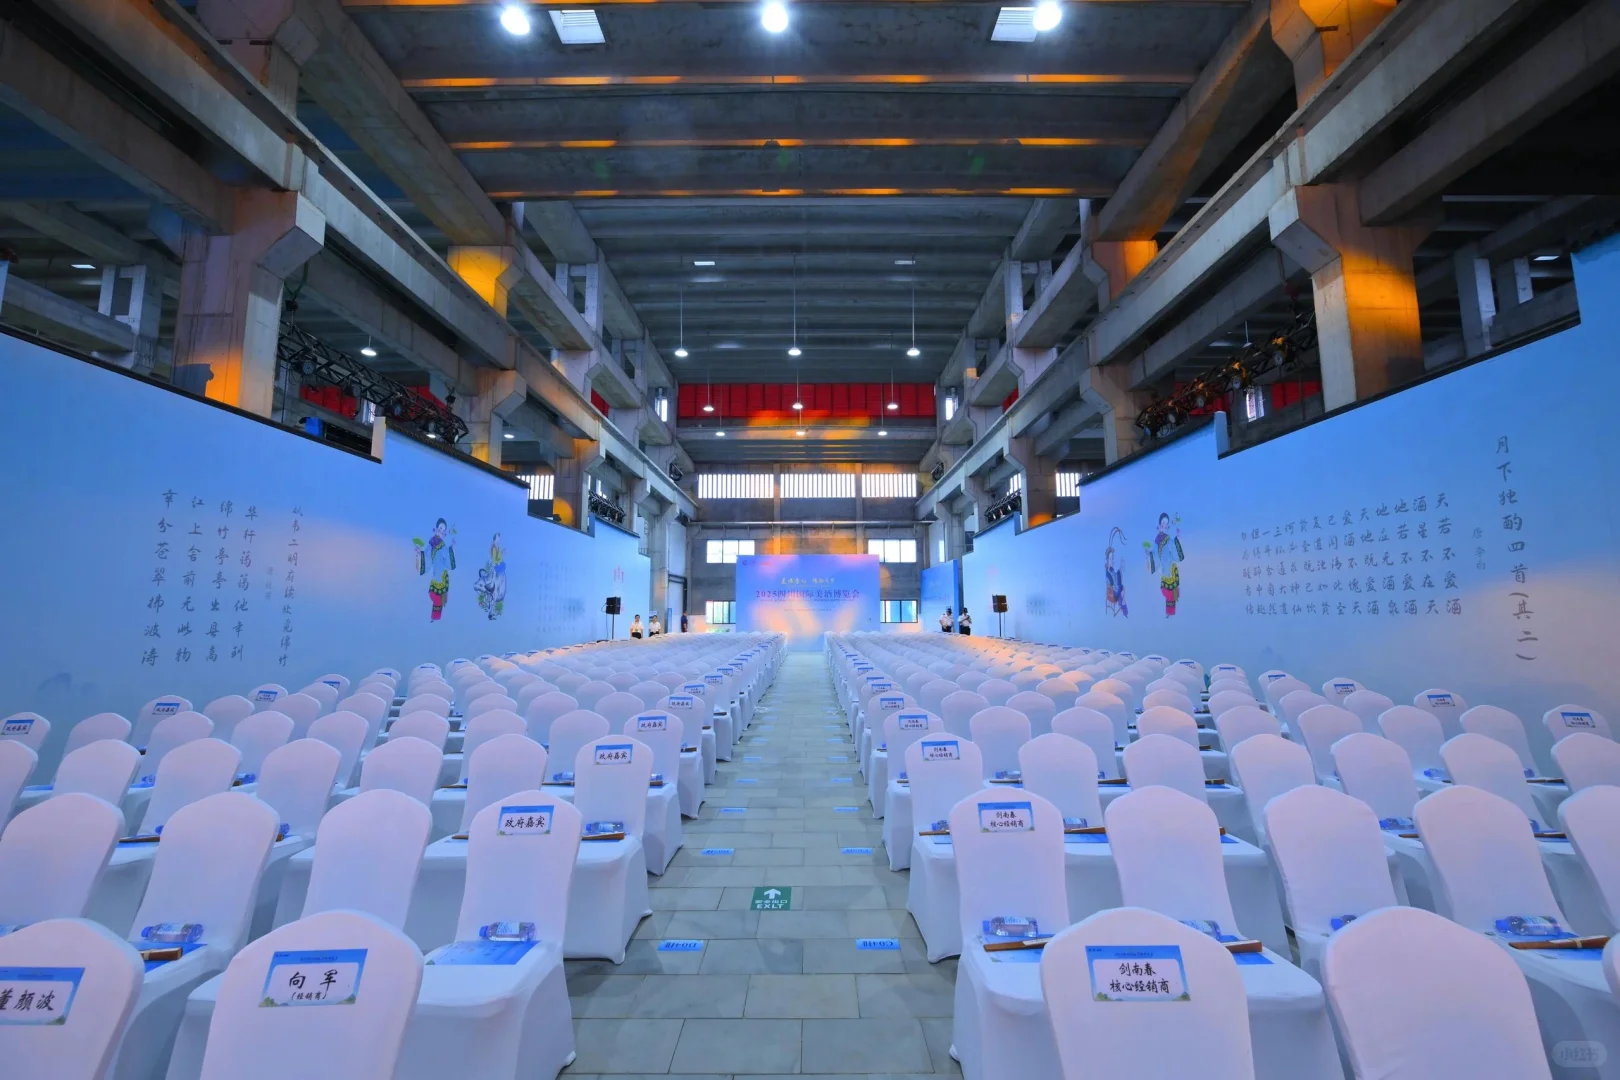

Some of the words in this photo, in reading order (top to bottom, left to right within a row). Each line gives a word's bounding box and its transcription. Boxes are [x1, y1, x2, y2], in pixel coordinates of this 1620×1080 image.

[142, 489, 178, 666] 幸分苍翠拂波涛
[175, 496, 204, 662] 江上舍前无此物
[205, 500, 234, 662] 绵竹亭亭出县高
[1342, 509, 1361, 615] 爱酒不愧天
[1359, 508, 1379, 616] 天地既爱酒
[1376, 500, 1399, 617] 地应无酒泉
[1393, 498, 1417, 616] 地若不爱酒
[1412, 496, 1439, 615] 酒星不在天
[1435, 493, 1461, 616] 天若不爱酒
[505, 815, 546, 829] 政府嘉宾
[990, 819, 1024, 828] 核心经销商
[996, 811, 1018, 819] 剑南春
[1109, 977, 1170, 993] 核心经销商
[1119, 962, 1156, 976] 剑南春
